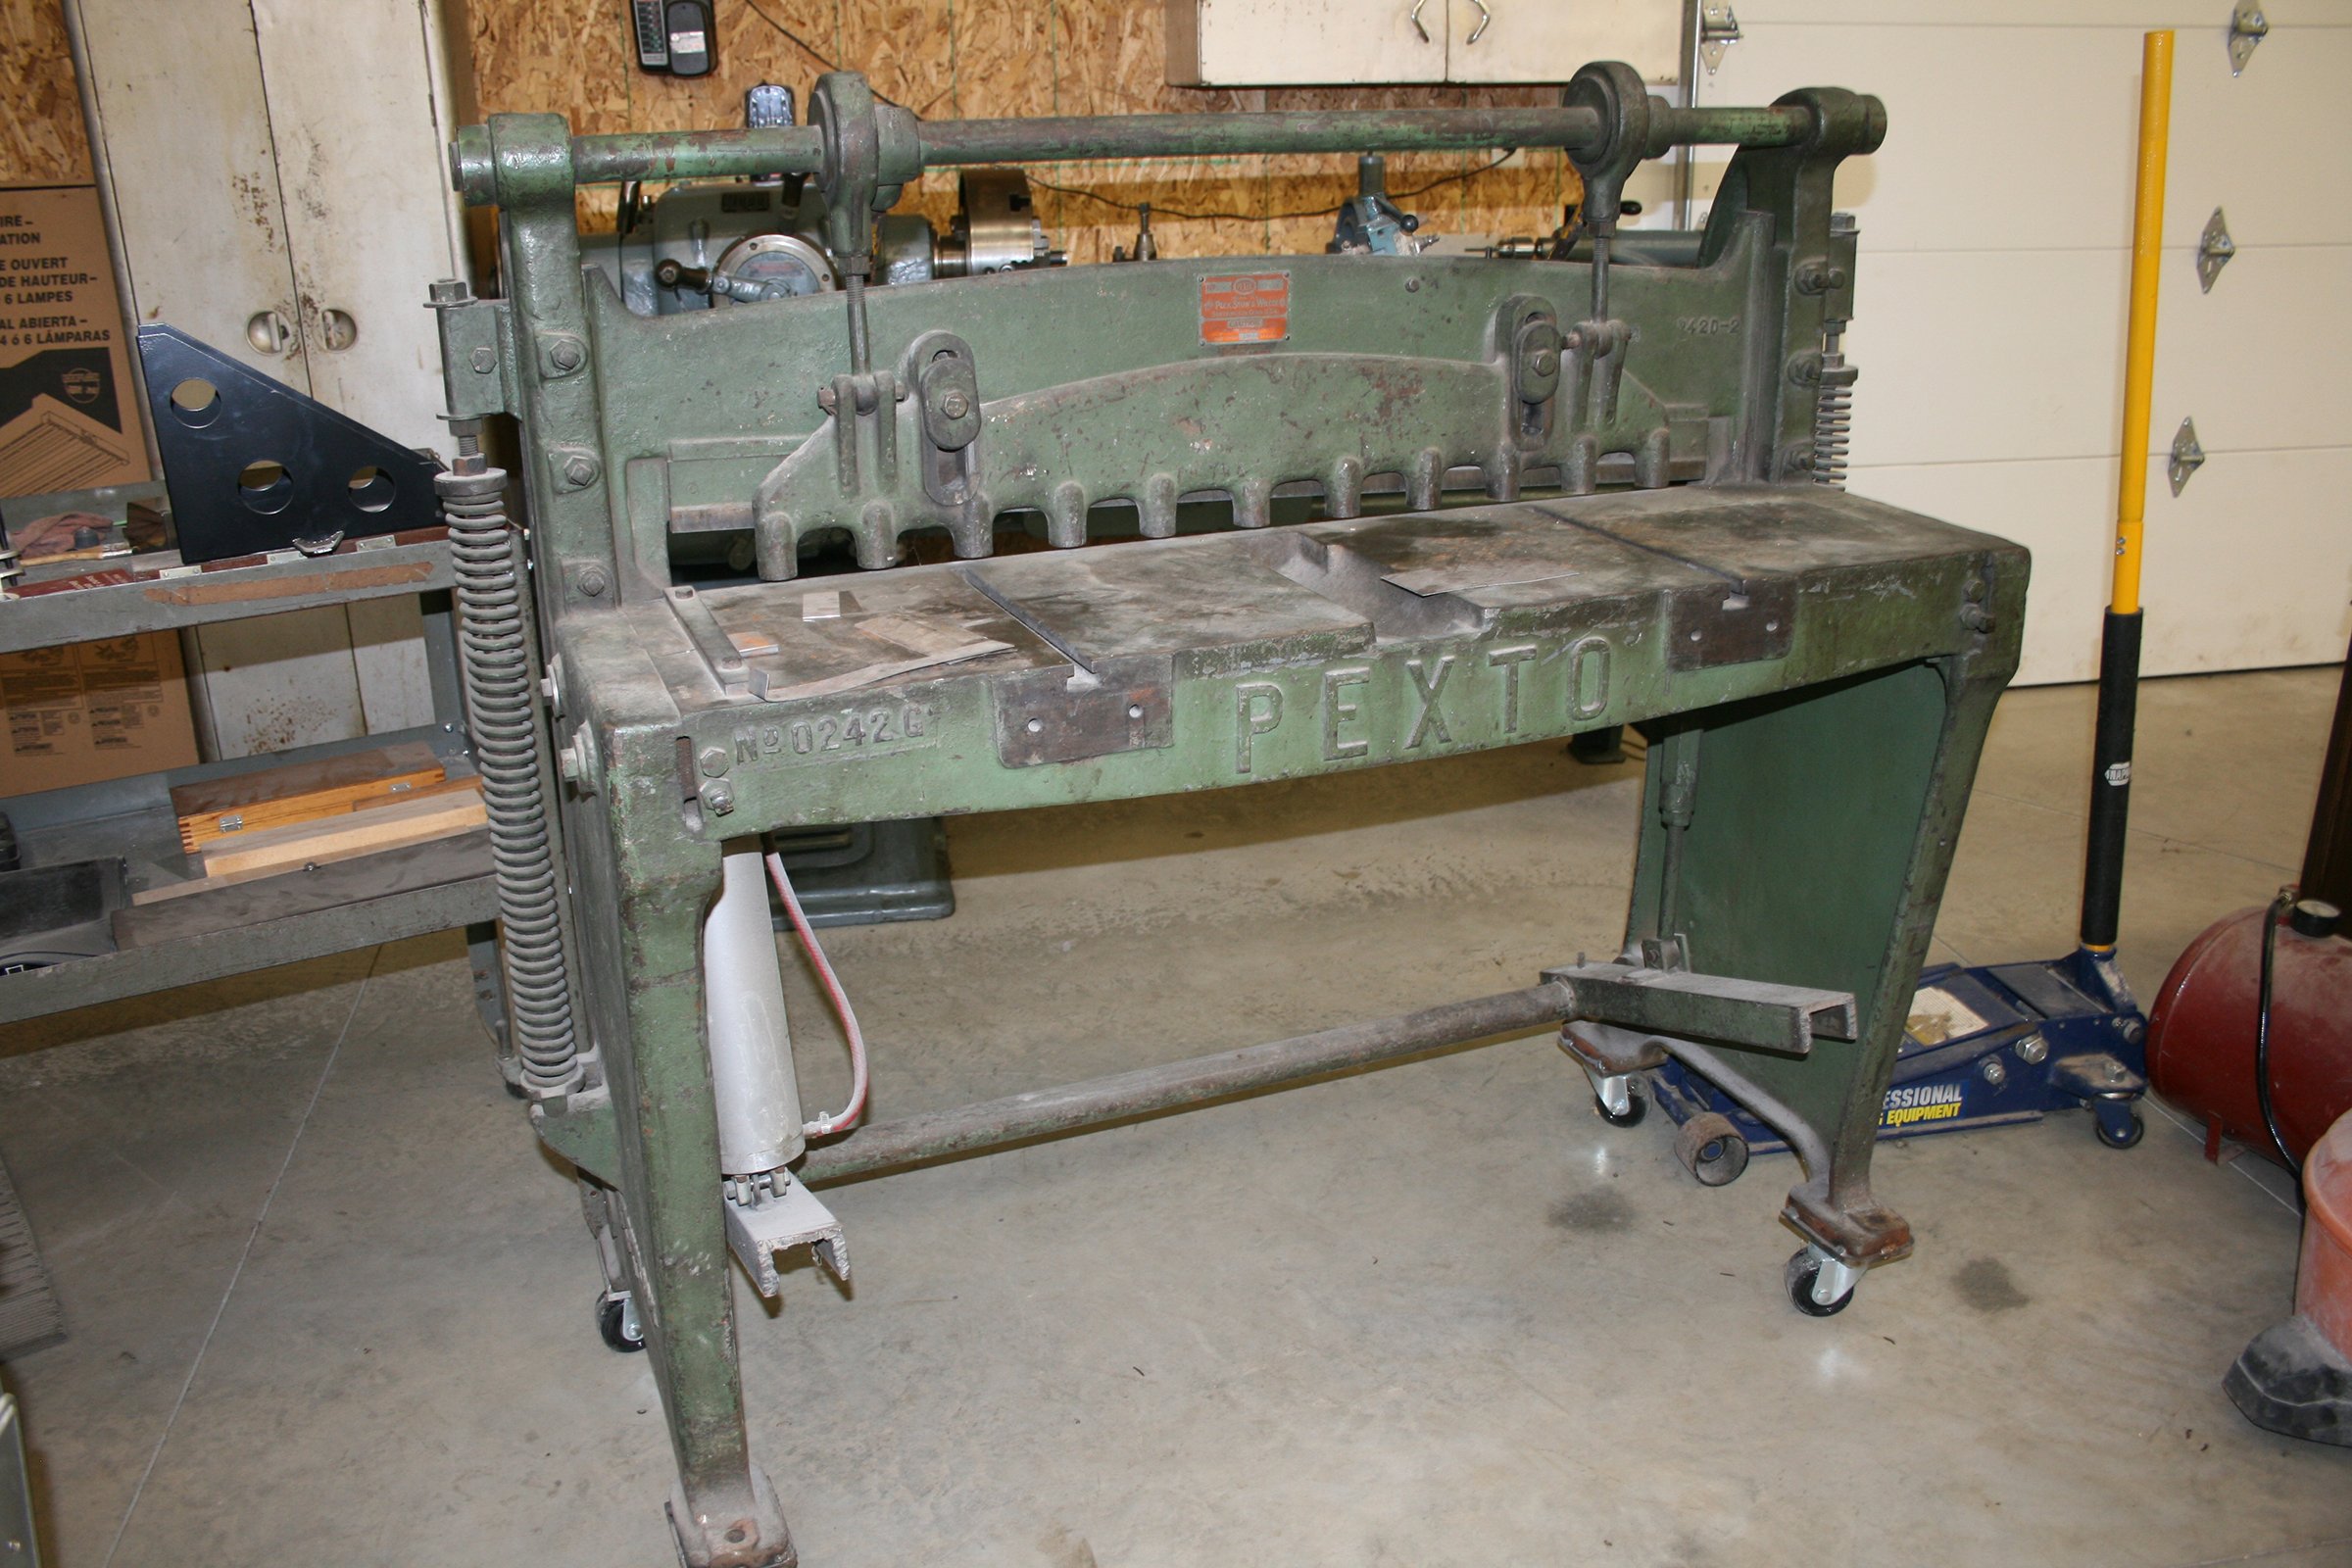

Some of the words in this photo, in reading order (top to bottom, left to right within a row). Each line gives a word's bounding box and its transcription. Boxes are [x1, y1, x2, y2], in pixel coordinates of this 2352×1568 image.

[11, 258, 68, 270] OUVERT
[5, 294, 13, 305] 6
[18, 291, 73, 304] LAMPES
[20, 317, 76, 328] ABIERTA
[24, 334, 32, 345] 6
[37, 329, 110, 344] LÁMPARAS
[1235, 636, 1611, 774] PEXTO
[1886, 1102, 1961, 1127] EQUIPMENT
